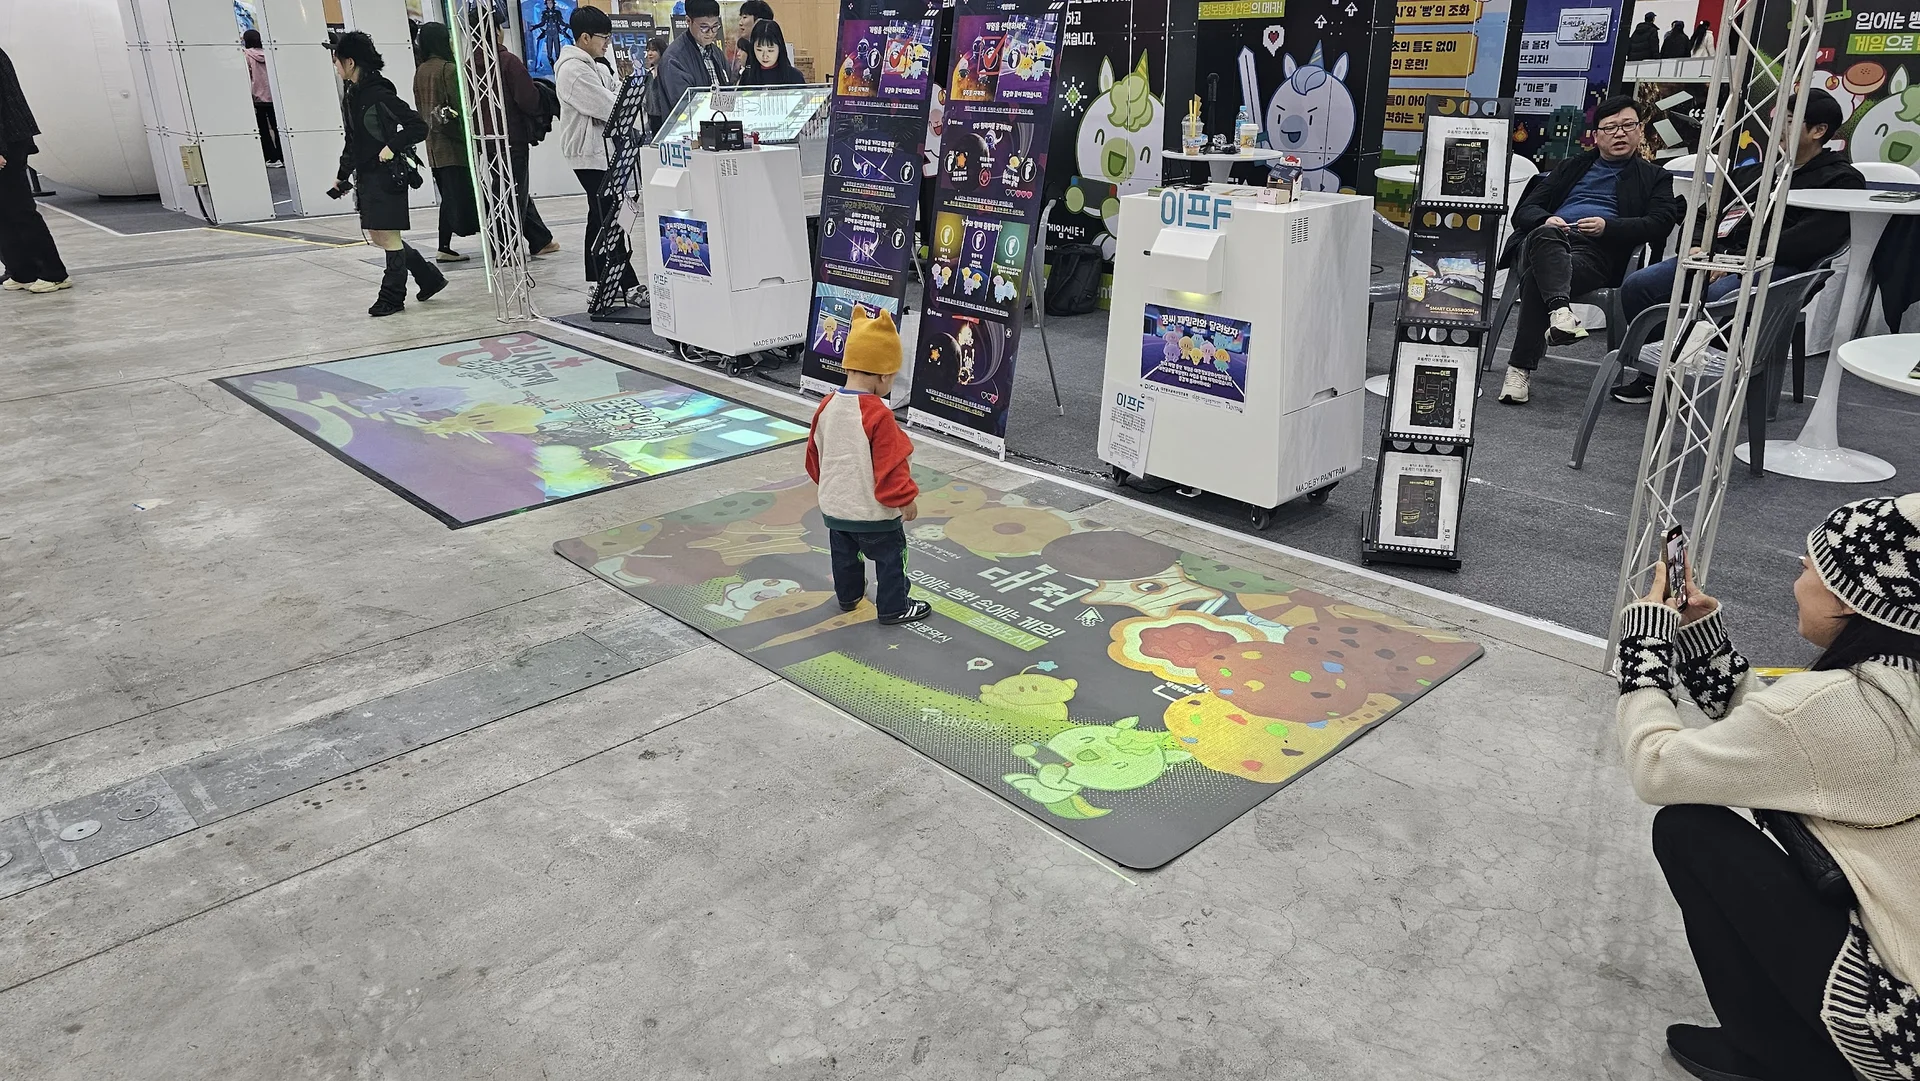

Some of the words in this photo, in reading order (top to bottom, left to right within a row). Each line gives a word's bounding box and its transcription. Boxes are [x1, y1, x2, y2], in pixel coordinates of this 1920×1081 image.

[1202, 2, 1234, 16] 정보문화
[1235, 2, 1261, 15] 산업의
[1262, 1, 1283, 14] 메카!
[1448, 4, 1470, 16] 조화
[1065, 11, 1082, 26] 하고
[1855, 11, 1906, 30] 입에는
[1436, 40, 1457, 53] 없이
[1854, 35, 1914, 52] 게임으로
[1405, 59, 1429, 70] 훈련!
[1160, 191, 1232, 230] 이프F
[1046, 223, 1085, 240] 게임센터
[753, 339, 769, 348] MADE
[777, 332, 803, 343] PAINTPAM
[1295, 480, 1313, 493] MADE
[1313, 477, 1320, 486] BY
[1321, 465, 1347, 483] PAINTPAM
[977, 563, 1092, 612] 대전
[906, 569, 951, 592] 입에는
[945, 587, 980, 603] 빵!
[971, 599, 1020, 622] 손에는
[1017, 616, 1067, 639] 게임!
[920, 707, 1005, 733] PAINTPAM
